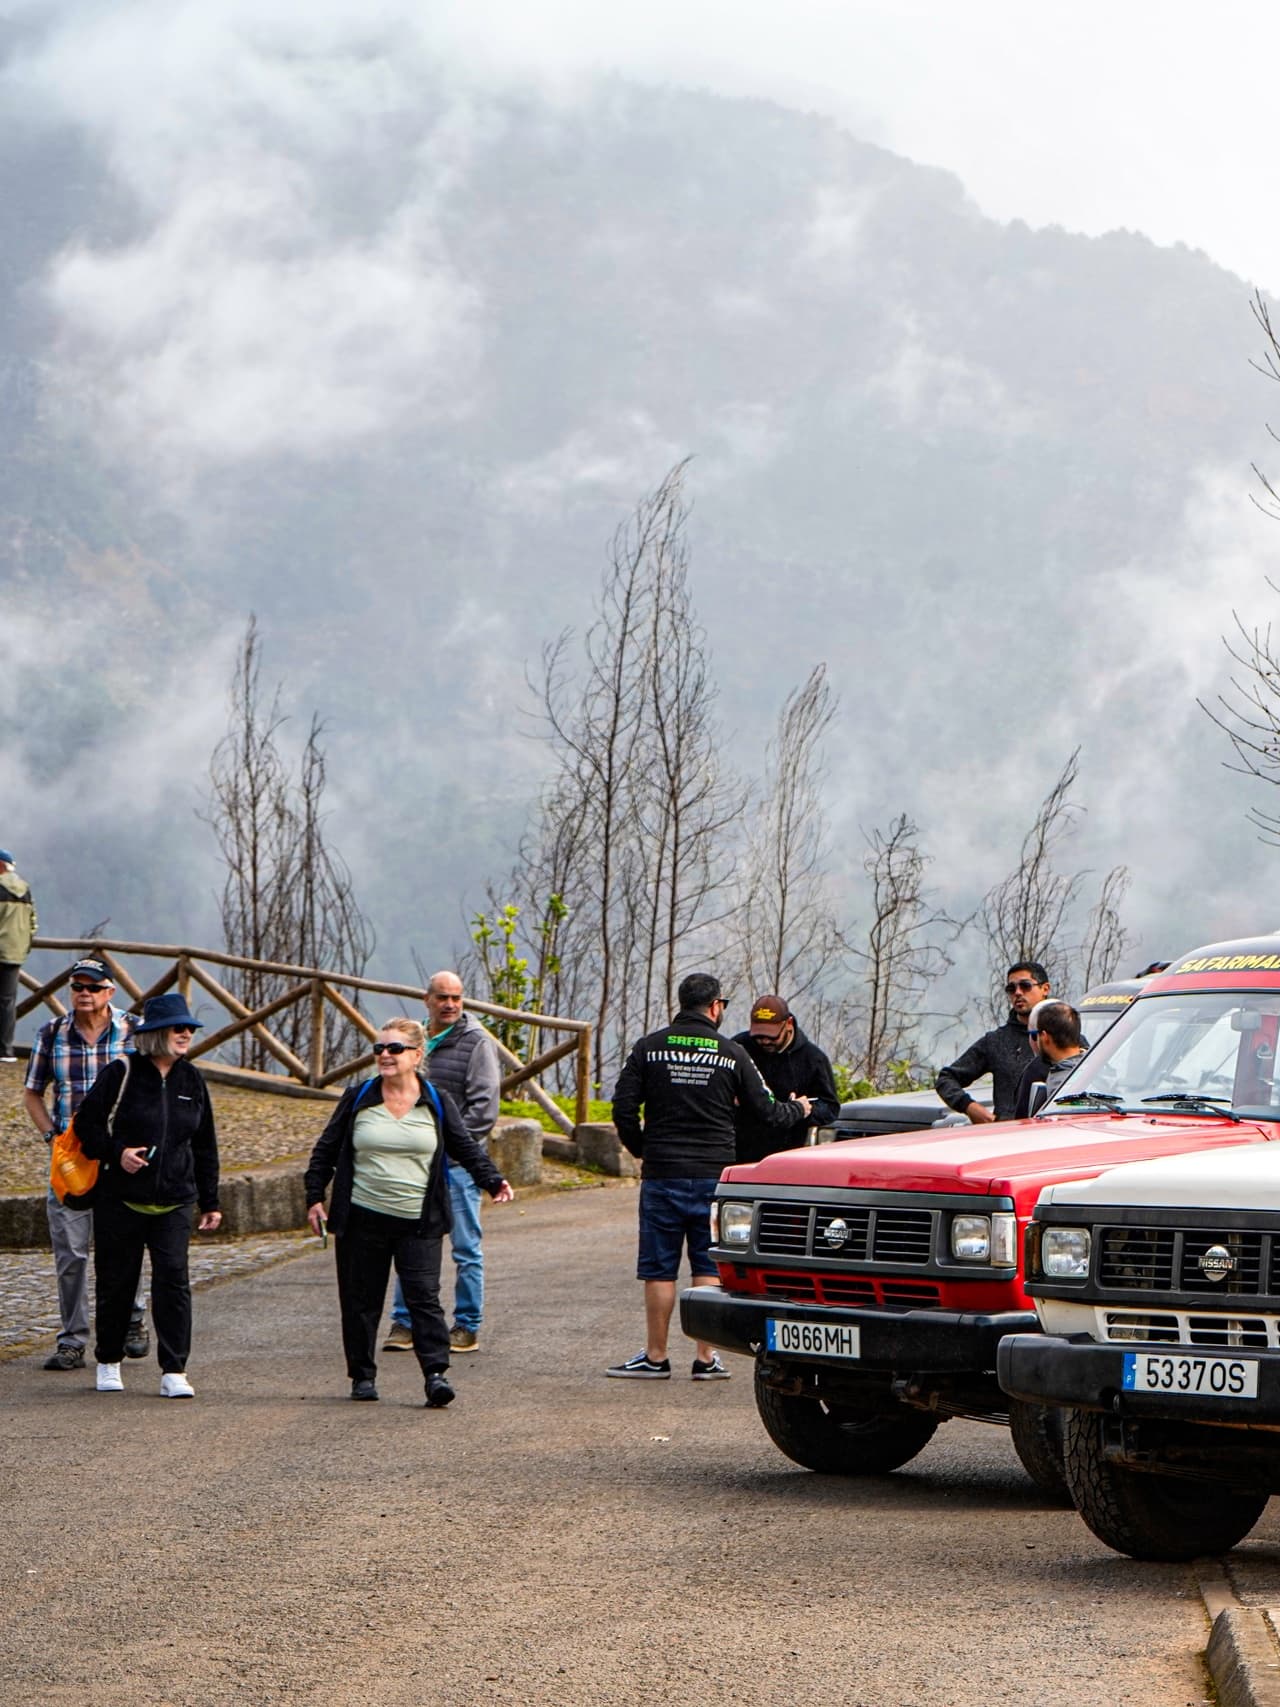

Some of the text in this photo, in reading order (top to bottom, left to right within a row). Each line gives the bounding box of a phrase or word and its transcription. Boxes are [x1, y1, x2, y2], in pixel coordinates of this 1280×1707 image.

[667, 1035, 719, 1049] SAFARI
[1199, 1257, 1233, 1269] NISSAN
[781, 1324, 852, 1355] 0966MH
